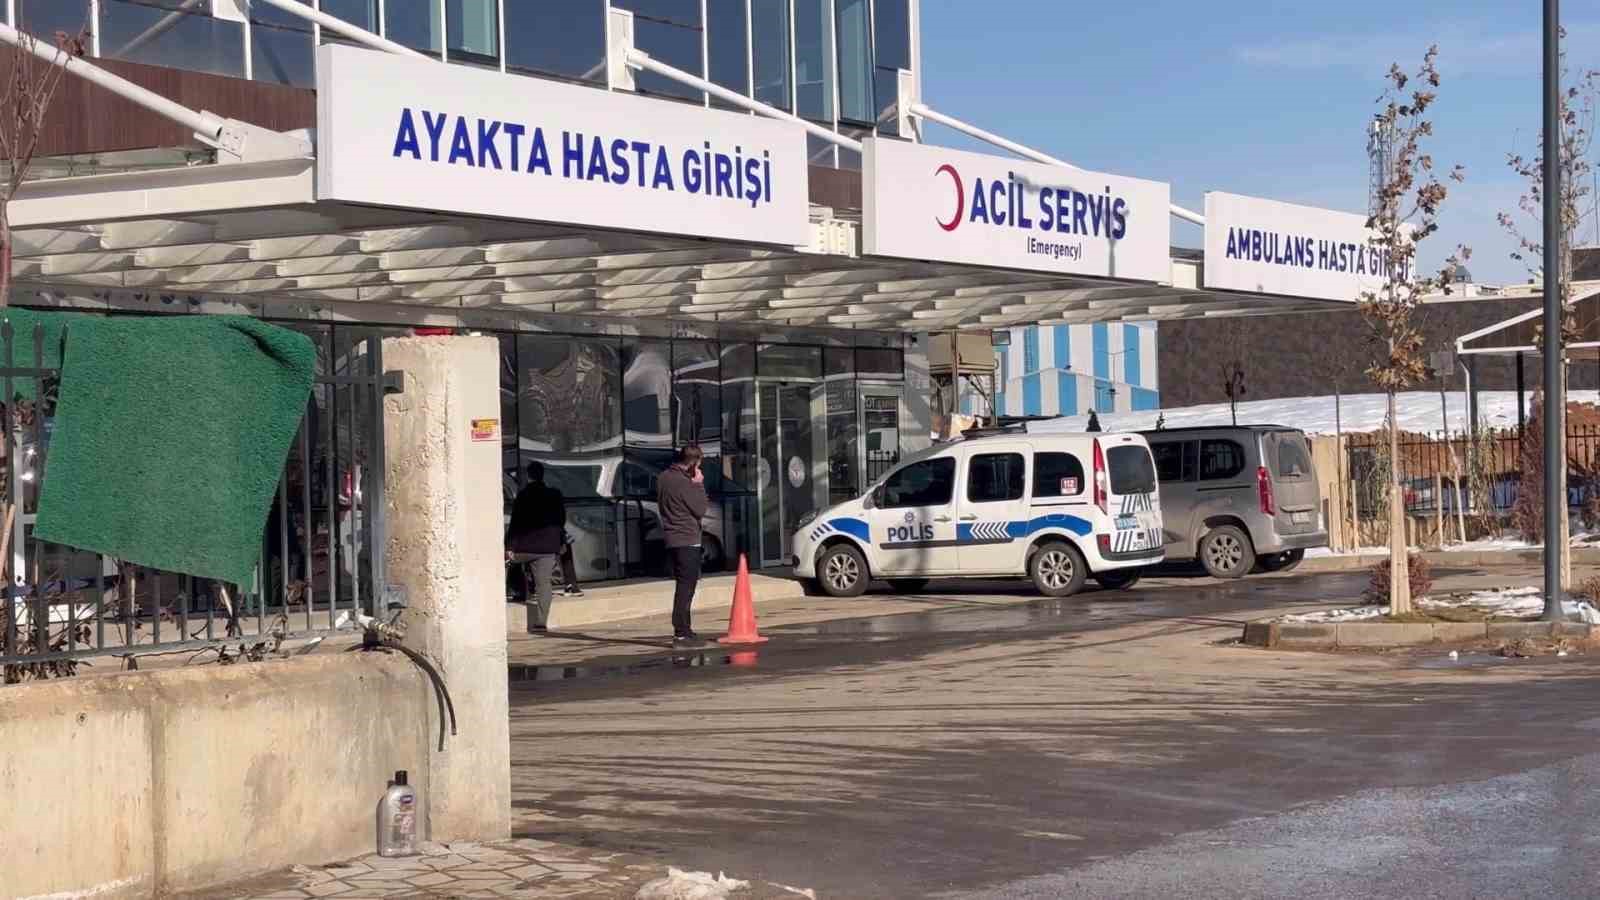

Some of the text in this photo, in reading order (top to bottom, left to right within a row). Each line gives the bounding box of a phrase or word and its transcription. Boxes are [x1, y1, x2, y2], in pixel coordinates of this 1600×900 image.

[393, 108, 771, 208] AYAKTA HASTA GİRİŞİ
[969, 171, 1127, 240] ACİL SERVİS
[1027, 236, 1082, 260] (Emergency)
[1225, 227, 1314, 268] AMBULANS
[1319, 240, 1365, 275] HASTA
[887, 522, 934, 541] POLİS
